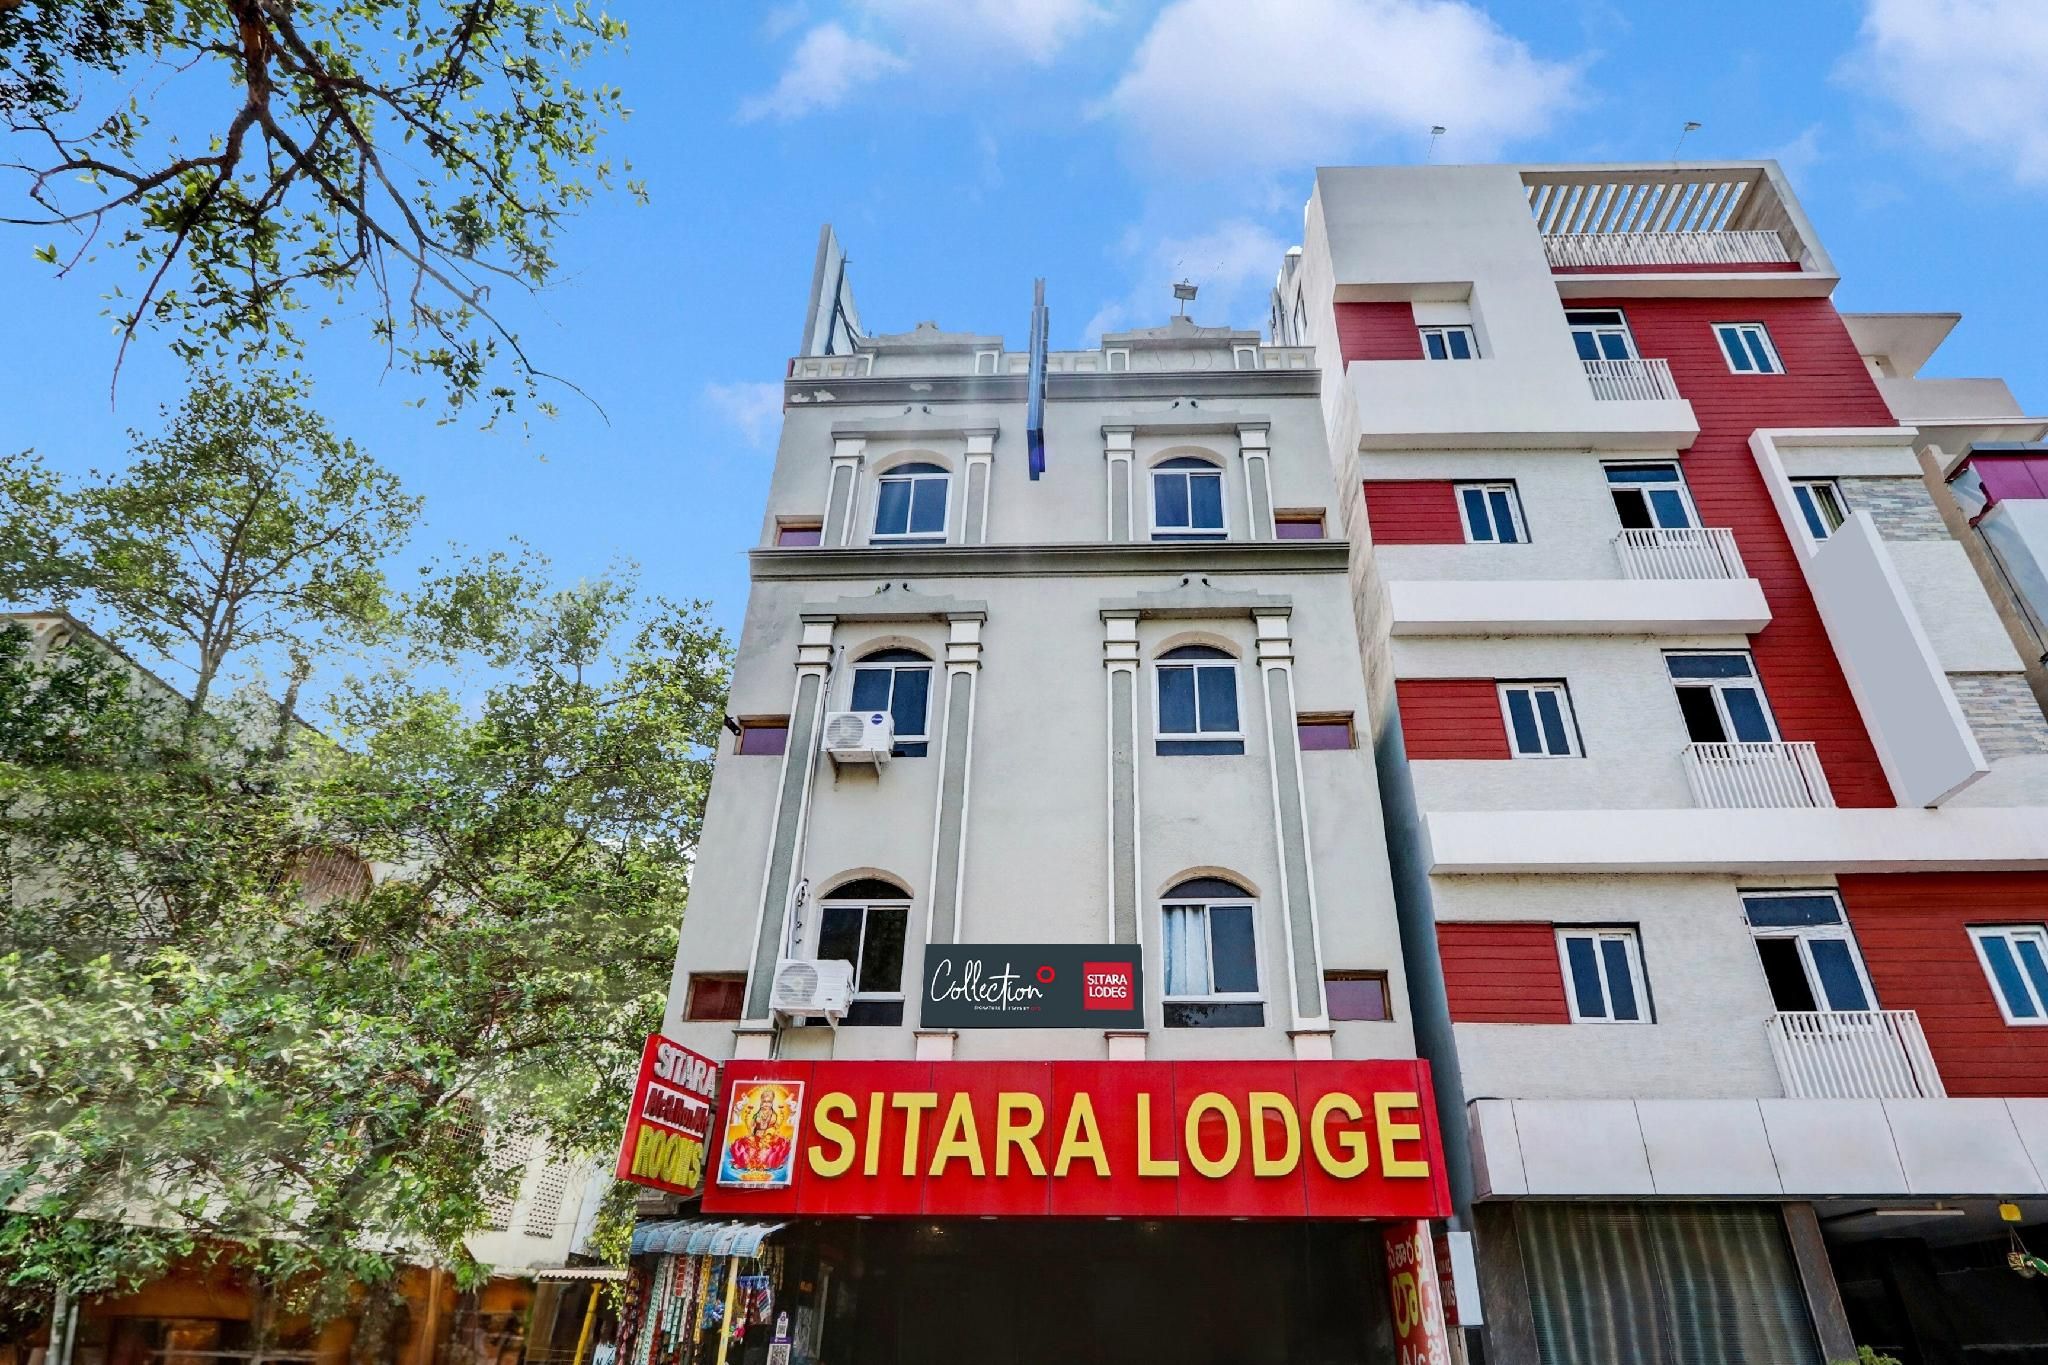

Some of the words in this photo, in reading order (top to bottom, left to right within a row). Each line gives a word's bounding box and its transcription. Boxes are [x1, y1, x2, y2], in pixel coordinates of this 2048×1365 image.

[931, 959, 1044, 1011] Collection
[1087, 973, 1128, 986] SITARA
[1089, 985, 1127, 999] LODEG
[654, 1043, 716, 1098] SITARA
[631, 1124, 704, 1189] ROOMS
[808, 1092, 1111, 1177] SITARA
[1137, 1092, 1430, 1178] LODGE
